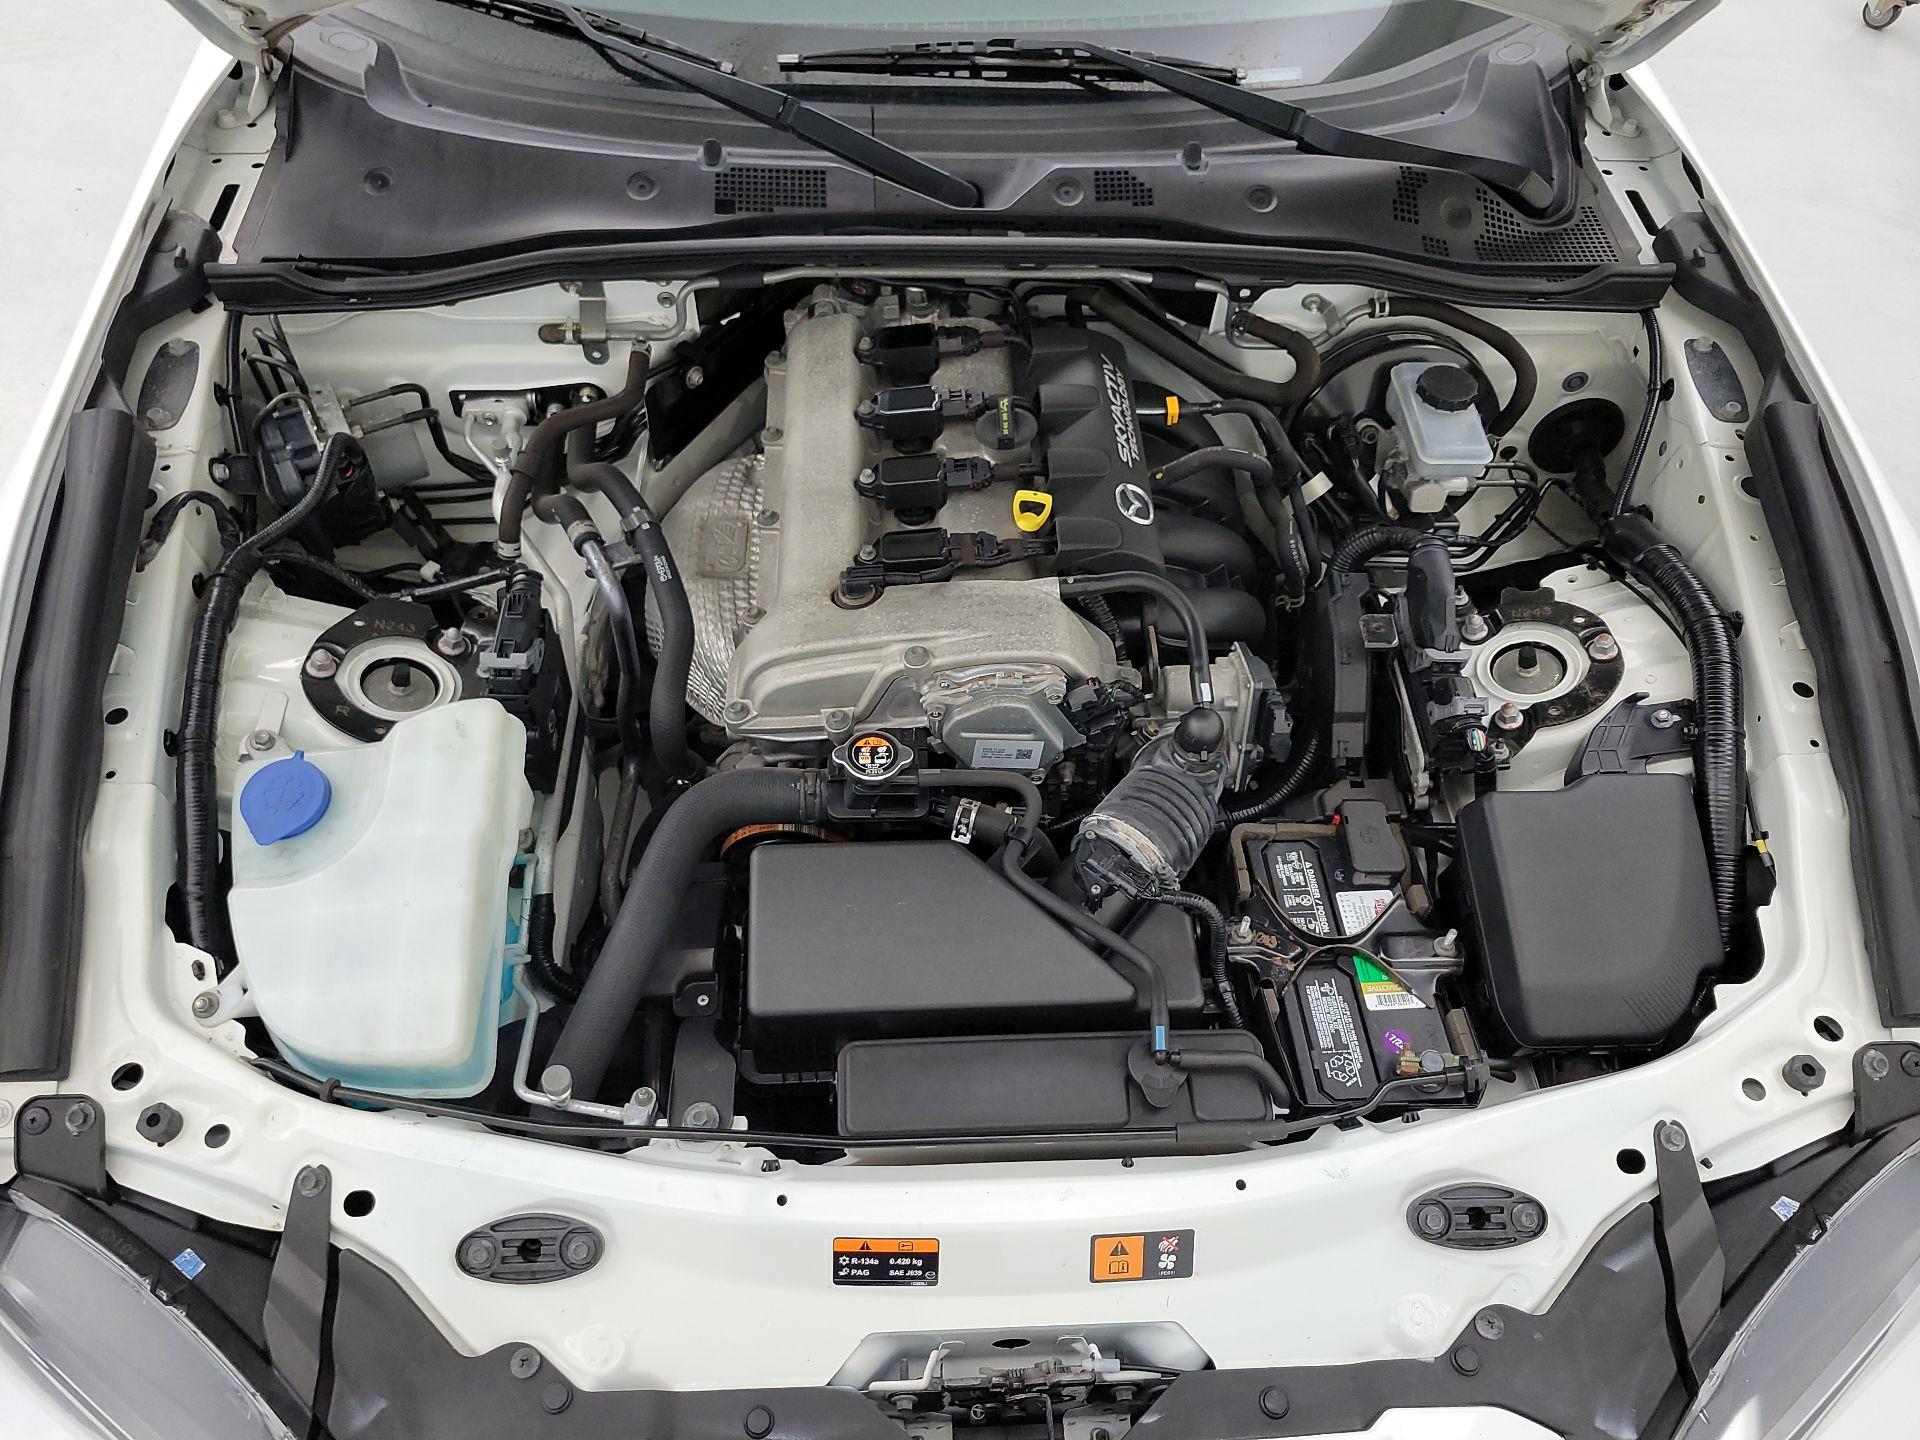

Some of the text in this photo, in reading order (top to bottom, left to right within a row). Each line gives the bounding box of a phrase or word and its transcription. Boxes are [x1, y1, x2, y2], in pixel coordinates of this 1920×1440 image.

[1100, 352, 1133, 469] SKYACTIV
[1115, 366, 1140, 462] TECHNOLOGY
[1306, 868, 1320, 901] DANGER
[1316, 905, 1330, 933] POISON
[851, 1257, 879, 1265] R-134a
[912, 1257, 922, 1266] kg
